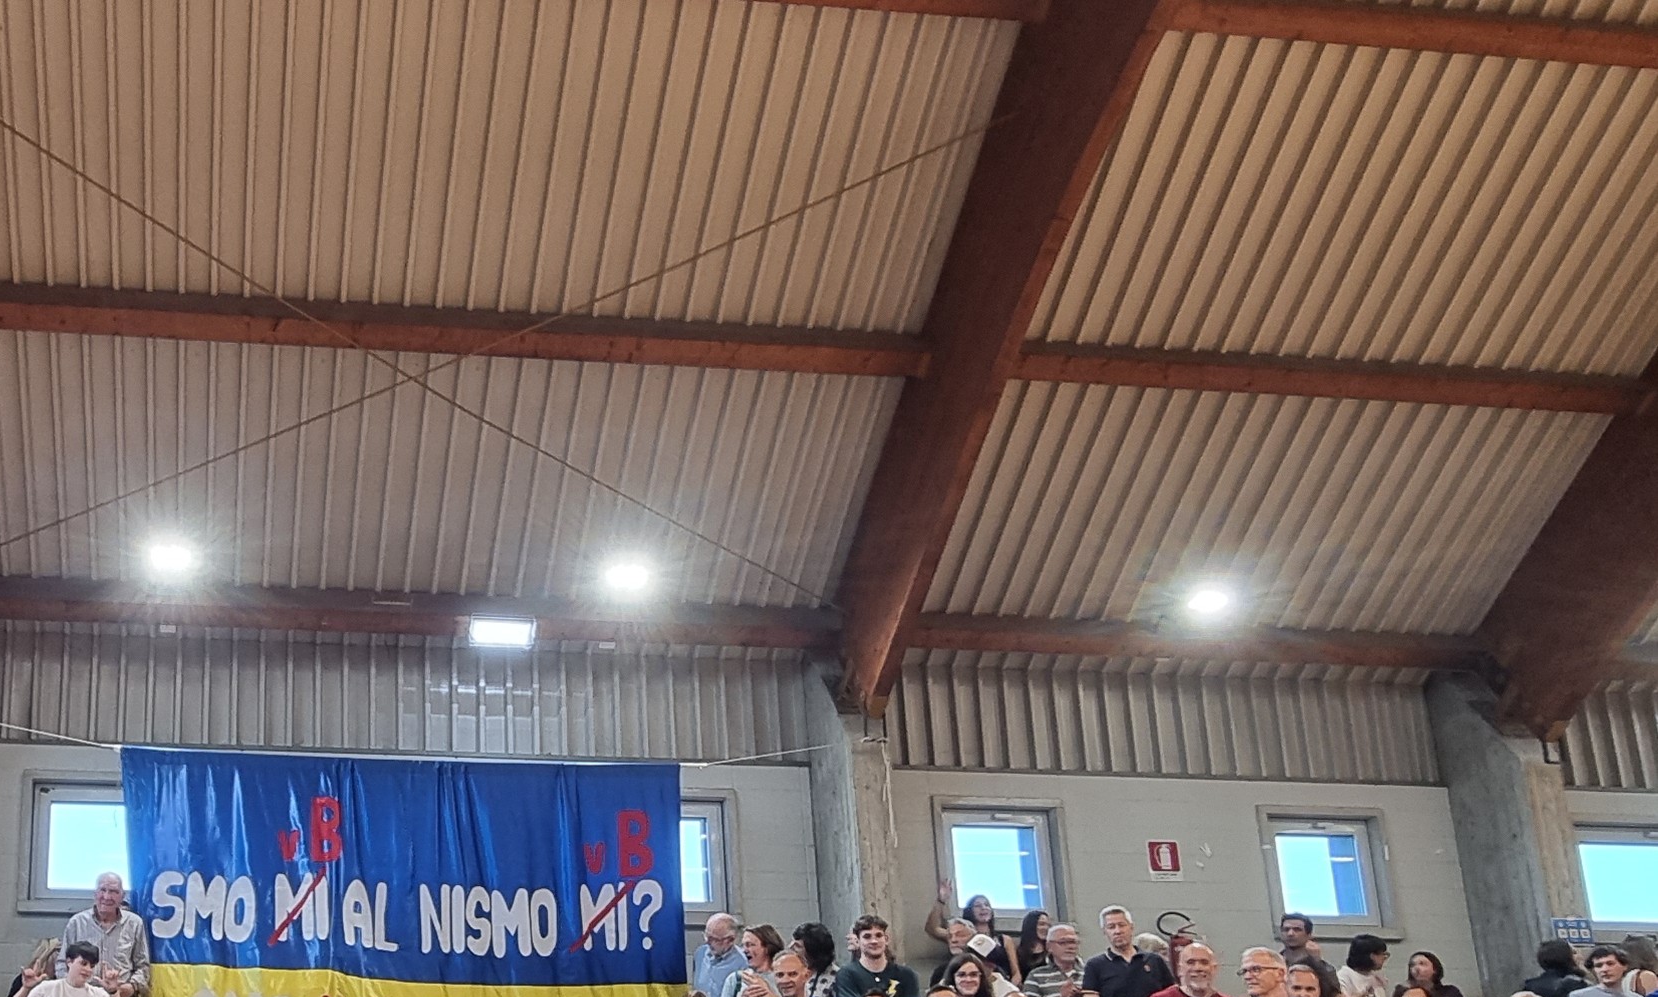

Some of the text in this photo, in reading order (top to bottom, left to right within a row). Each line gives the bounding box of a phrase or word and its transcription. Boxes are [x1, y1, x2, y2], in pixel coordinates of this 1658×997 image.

[151, 870, 663, 958] SMO MI AL NISMO MI?
